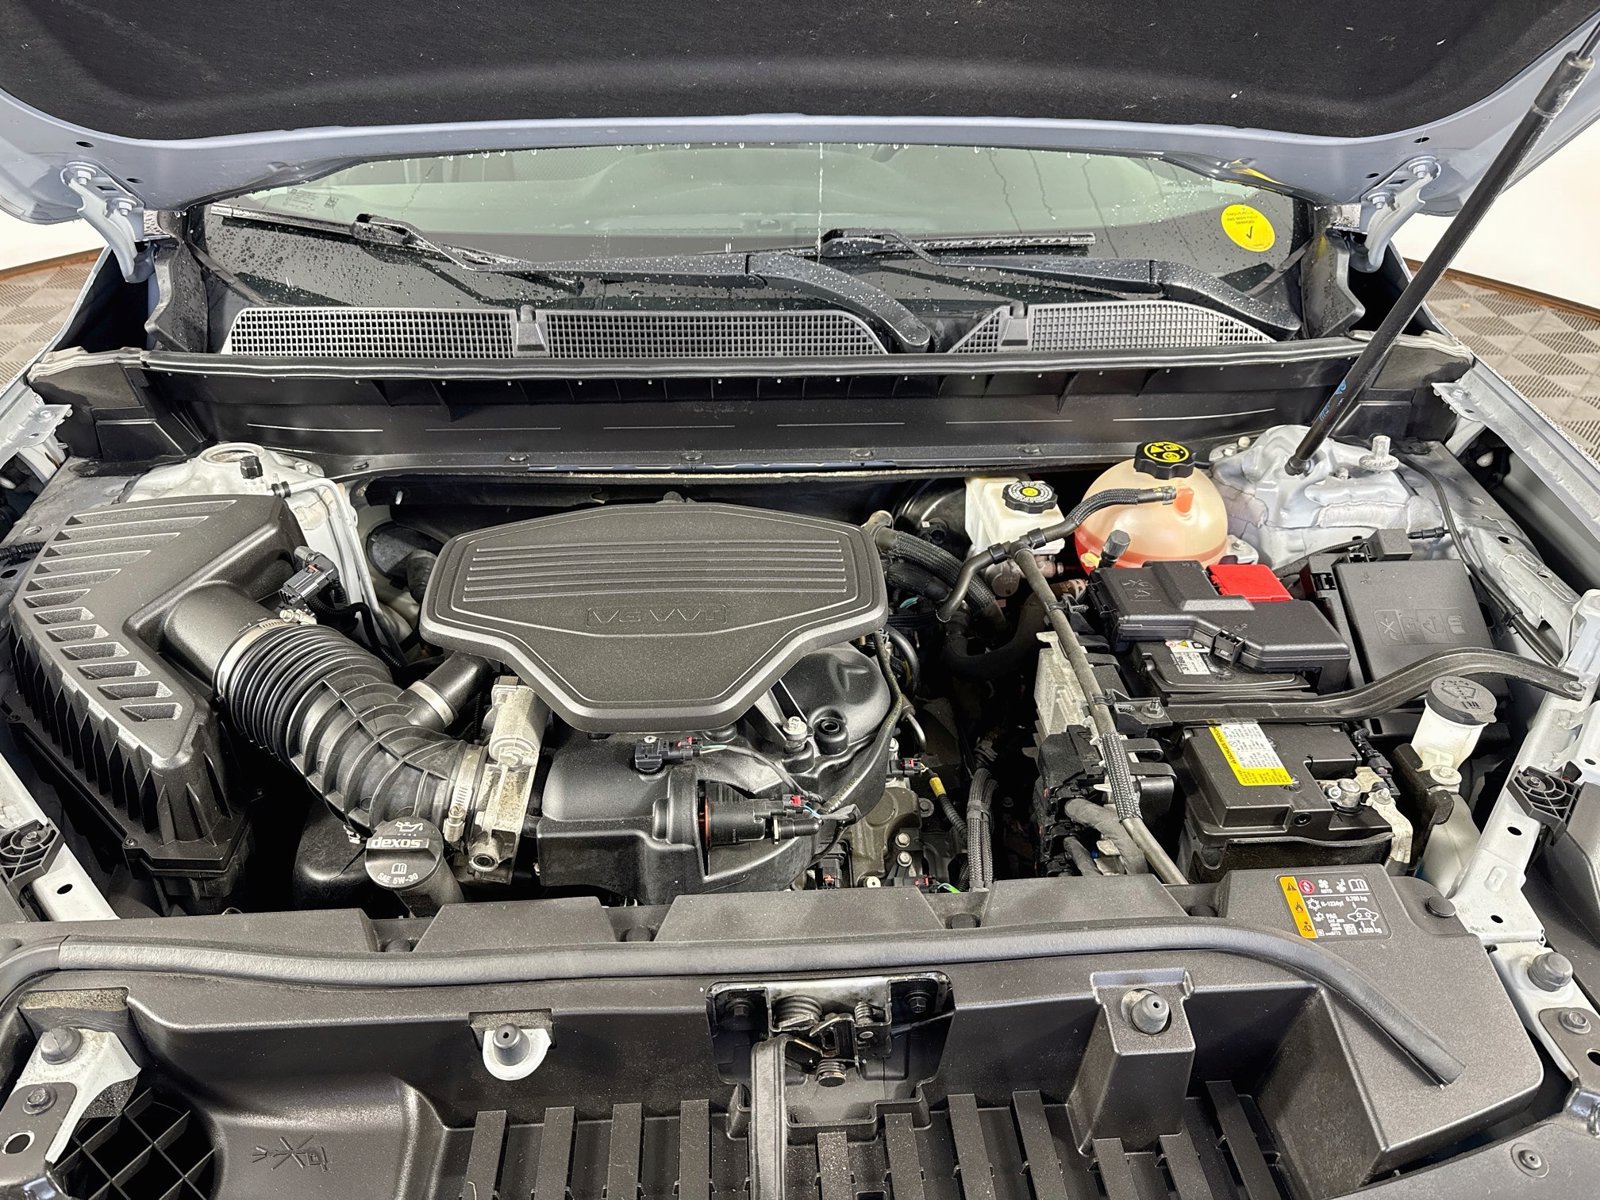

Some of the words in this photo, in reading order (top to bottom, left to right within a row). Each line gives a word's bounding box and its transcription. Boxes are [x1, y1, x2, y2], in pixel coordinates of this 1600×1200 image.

[370, 836, 423, 848] dexos
[377, 872, 391, 883] SAE
[392, 872, 419, 884] 5W-30
